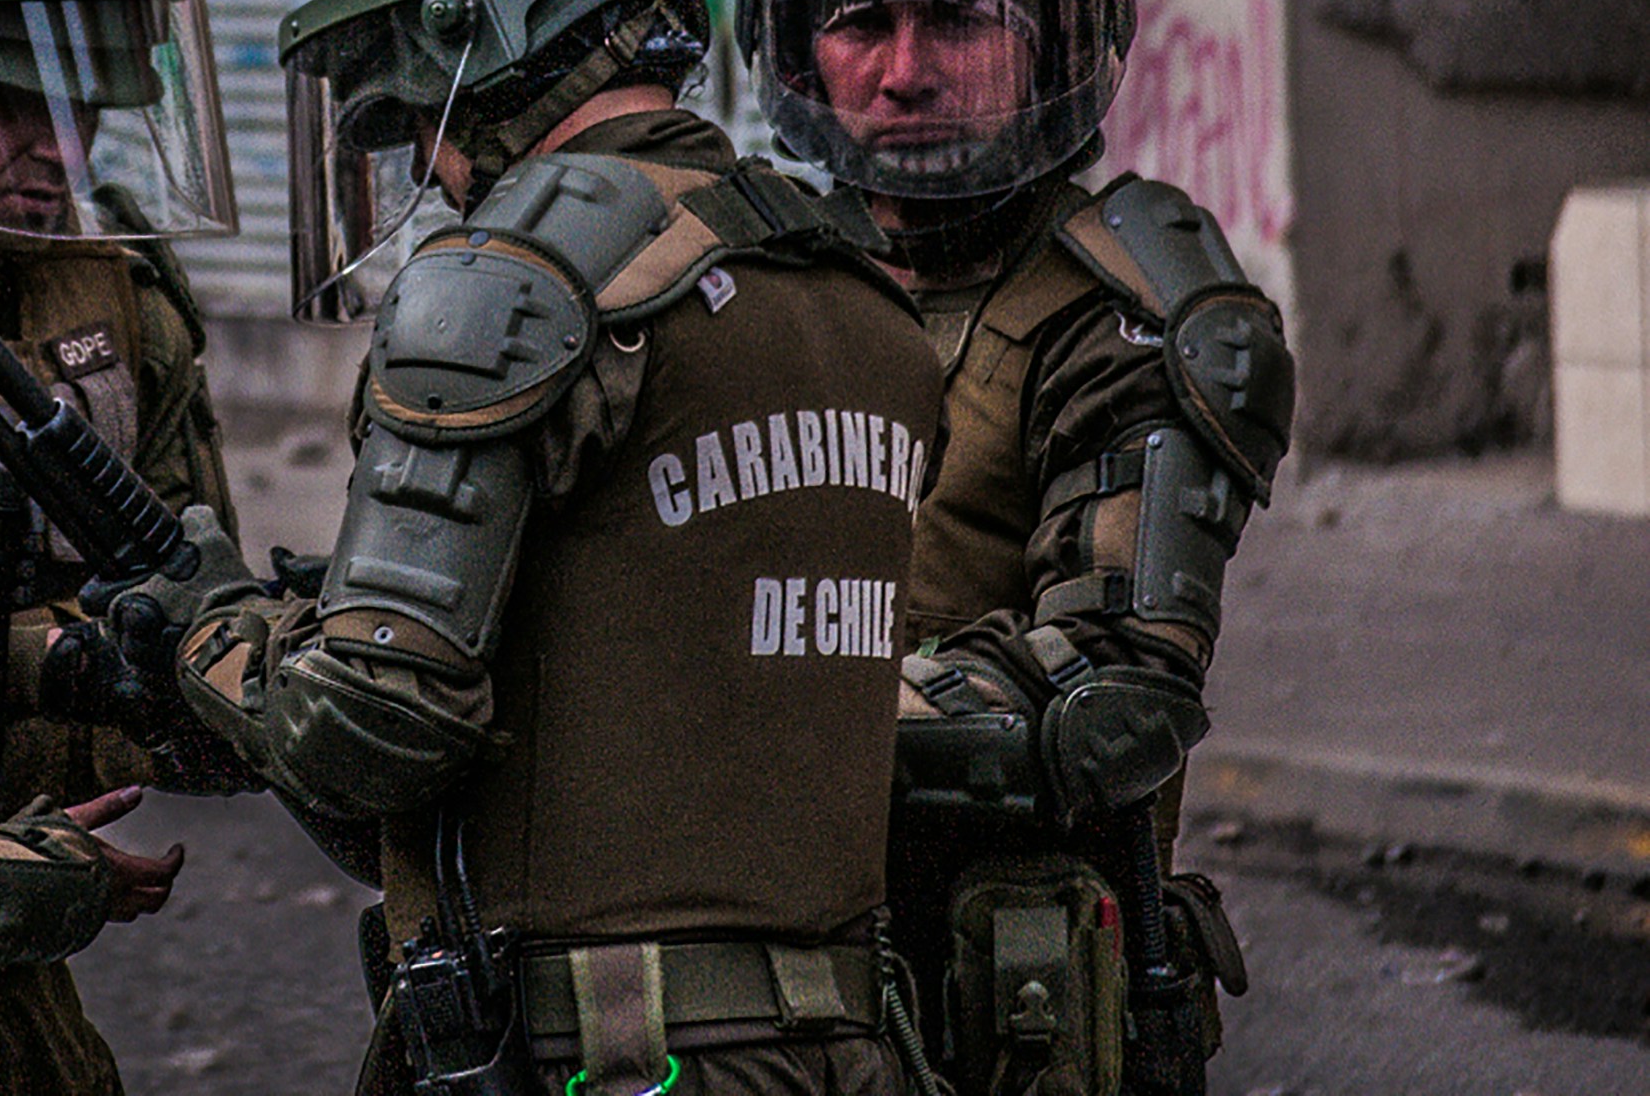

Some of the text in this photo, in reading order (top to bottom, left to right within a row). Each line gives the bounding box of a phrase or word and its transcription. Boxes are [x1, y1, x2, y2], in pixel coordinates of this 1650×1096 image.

[59, 332, 113, 367] GOPE
[647, 408, 928, 528] CARABINERO
[750, 576, 896, 660] DE CHILE
